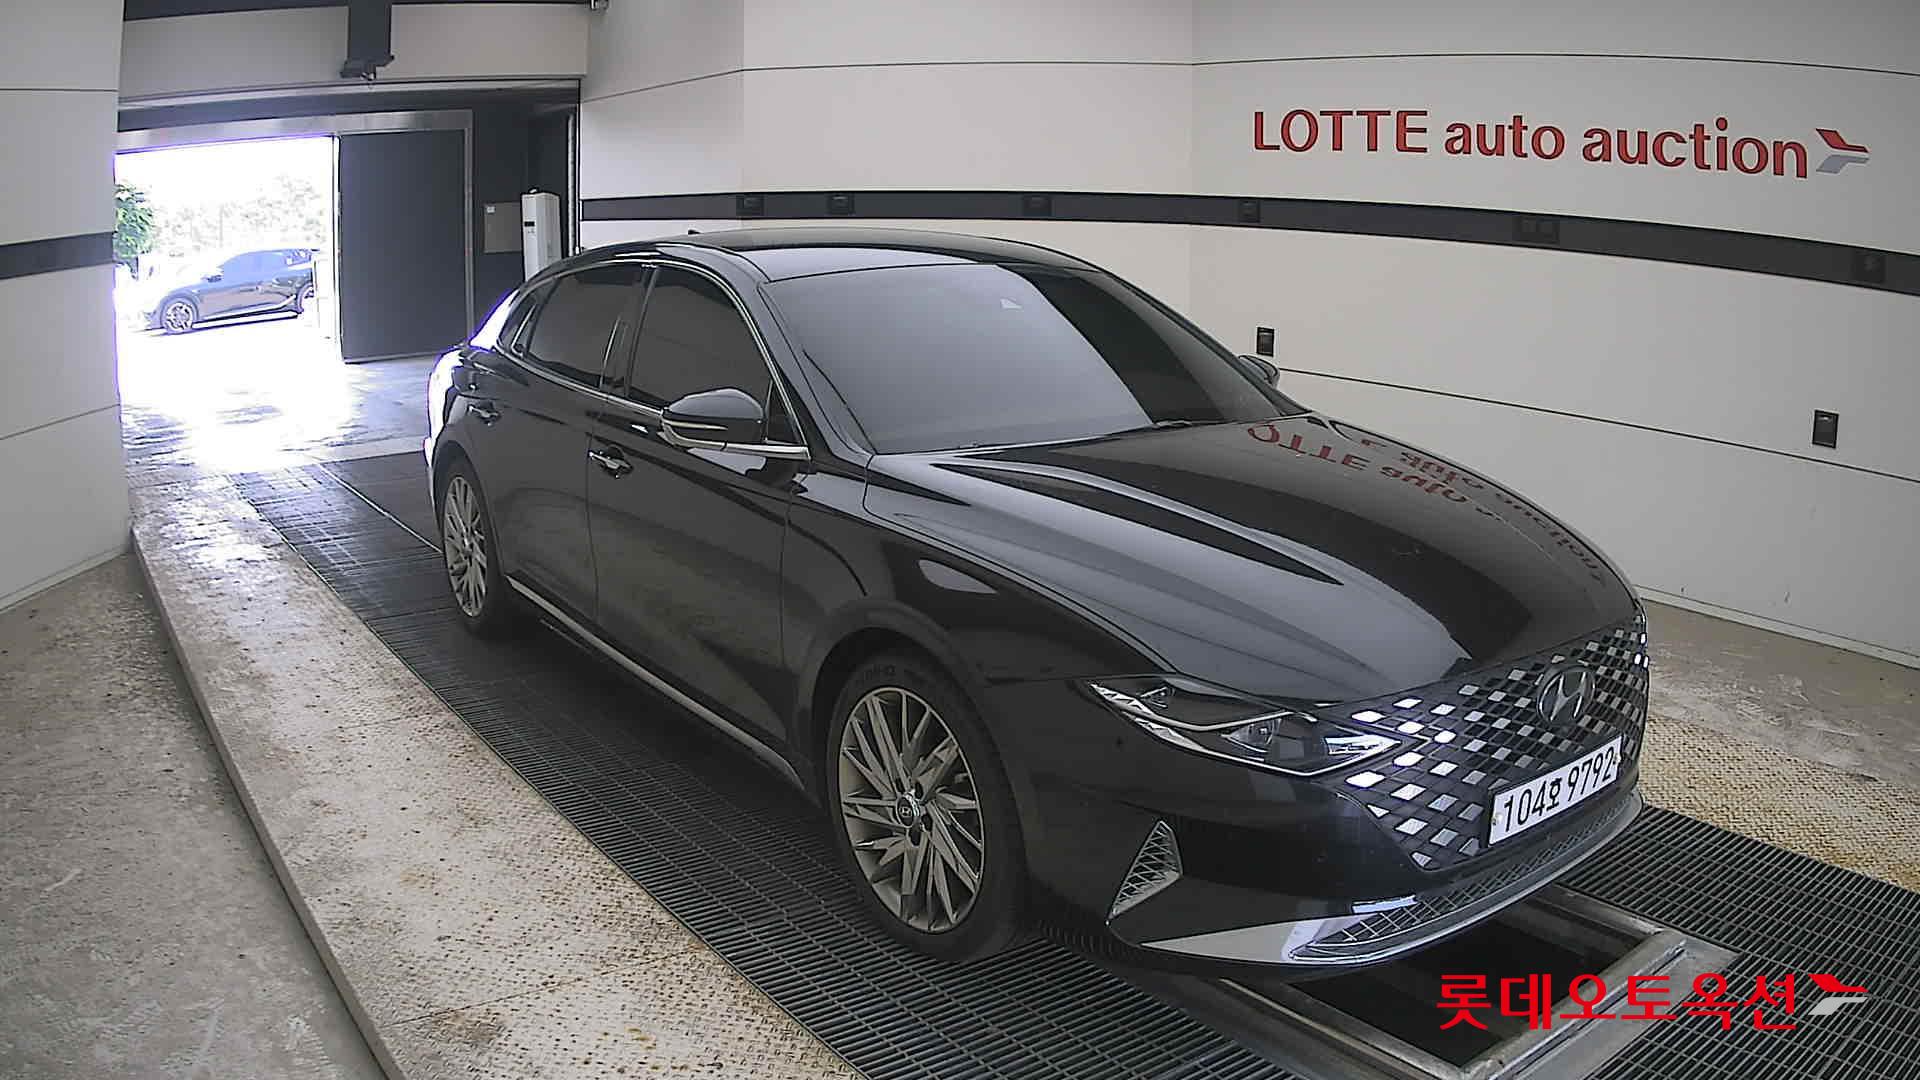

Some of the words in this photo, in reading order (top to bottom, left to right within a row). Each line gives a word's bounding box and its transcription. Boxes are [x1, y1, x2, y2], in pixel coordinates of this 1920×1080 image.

[1253, 109, 1429, 154] LOTTE
[1444, 115, 1566, 161] auto
[1582, 117, 1809, 180] auction
[1567, 746, 1615, 802] 9792
